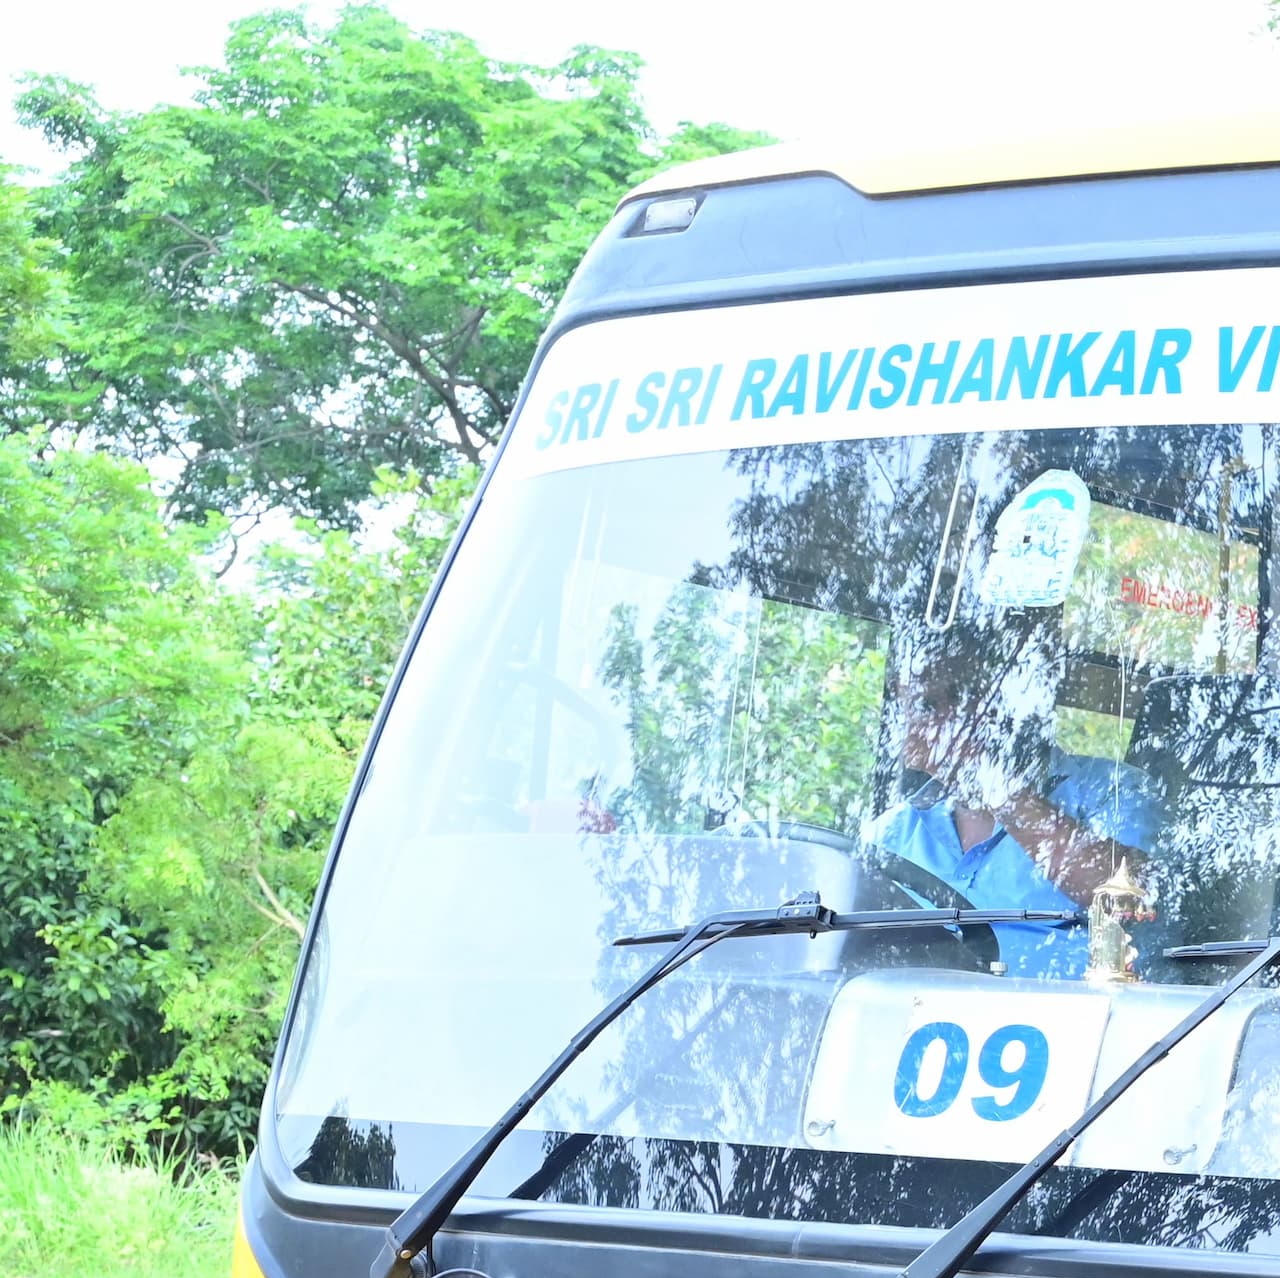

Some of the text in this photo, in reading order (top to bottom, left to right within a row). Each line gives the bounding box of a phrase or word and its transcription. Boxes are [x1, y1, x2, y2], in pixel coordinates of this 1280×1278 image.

[535, 379, 619, 451] SRI
[626, 364, 723, 433] SRI
[730, 328, 1192, 421] RAVISHANKAR
[893, 1022, 1050, 1122] 09
